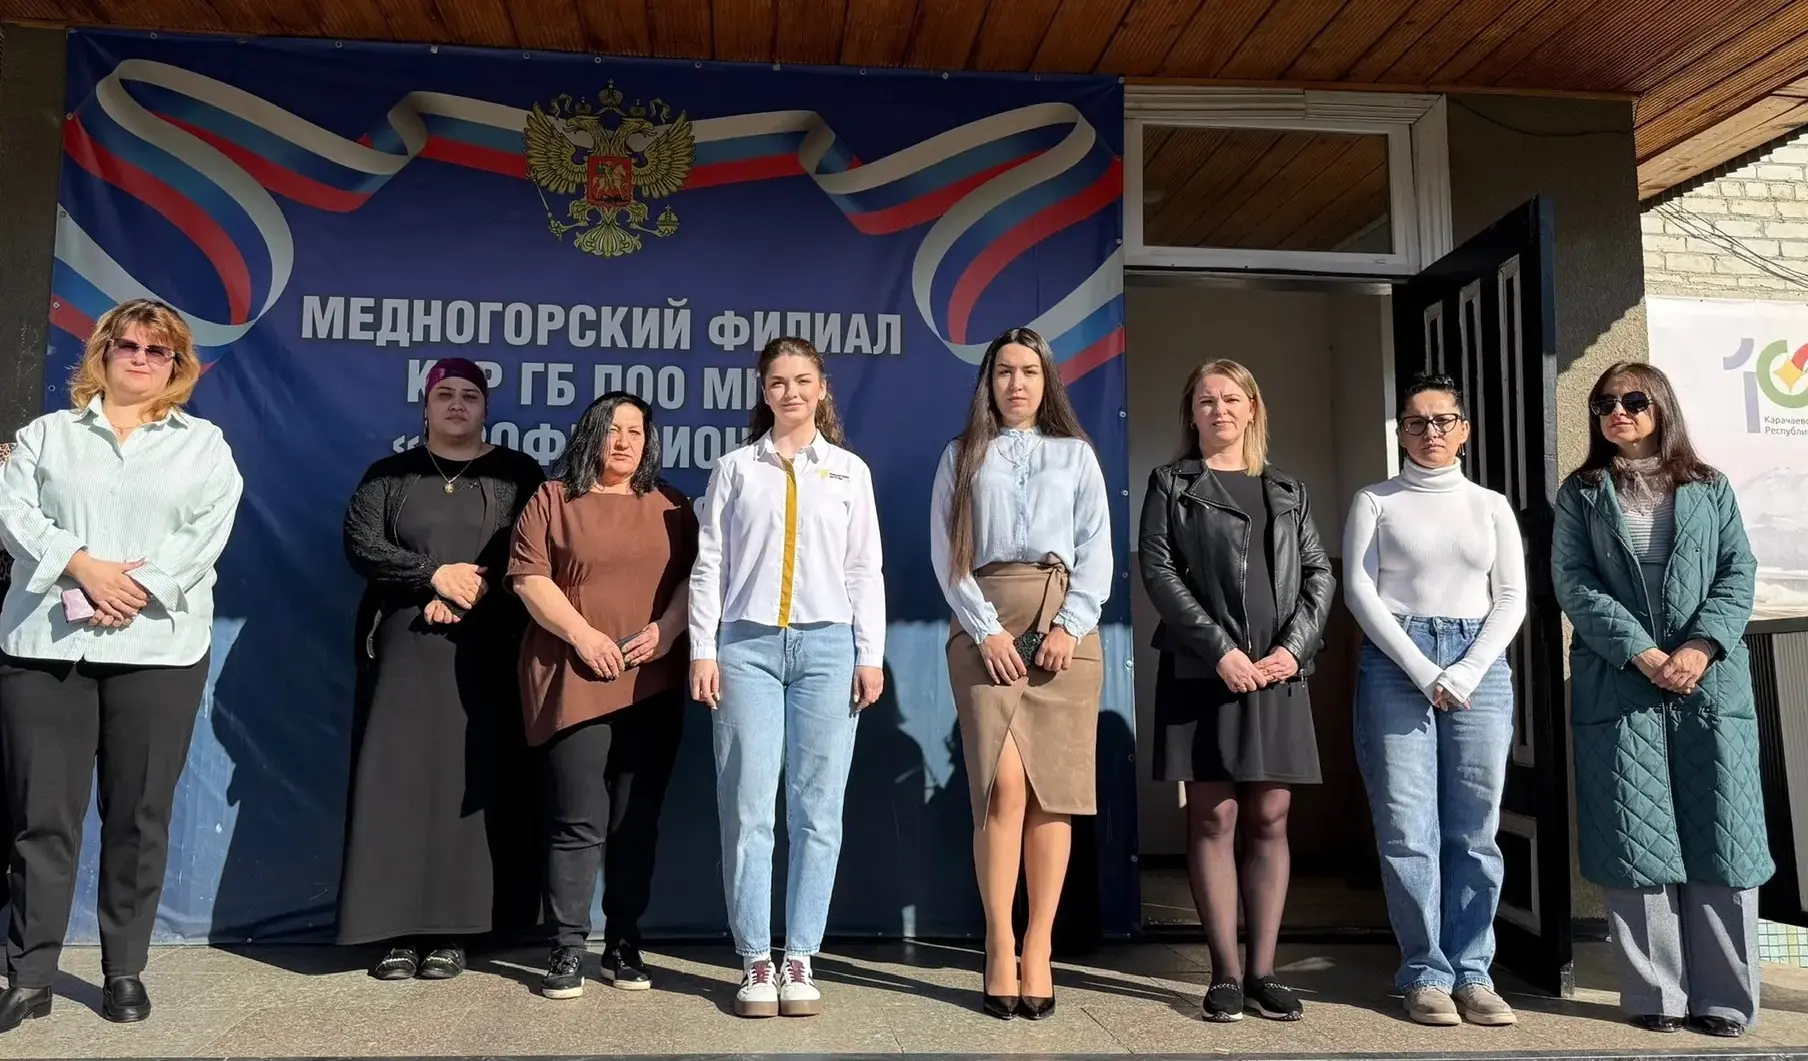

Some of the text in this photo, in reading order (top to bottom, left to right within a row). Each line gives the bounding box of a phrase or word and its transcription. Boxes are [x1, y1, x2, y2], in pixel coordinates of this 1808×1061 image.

[301, 295, 902, 355] МЕДНОГОРСКИЙ ФИЛИАЛ
[407, 359, 503, 403] КР
[520, 362, 576, 406] ГБ
[594, 364, 685, 410] ПОО
